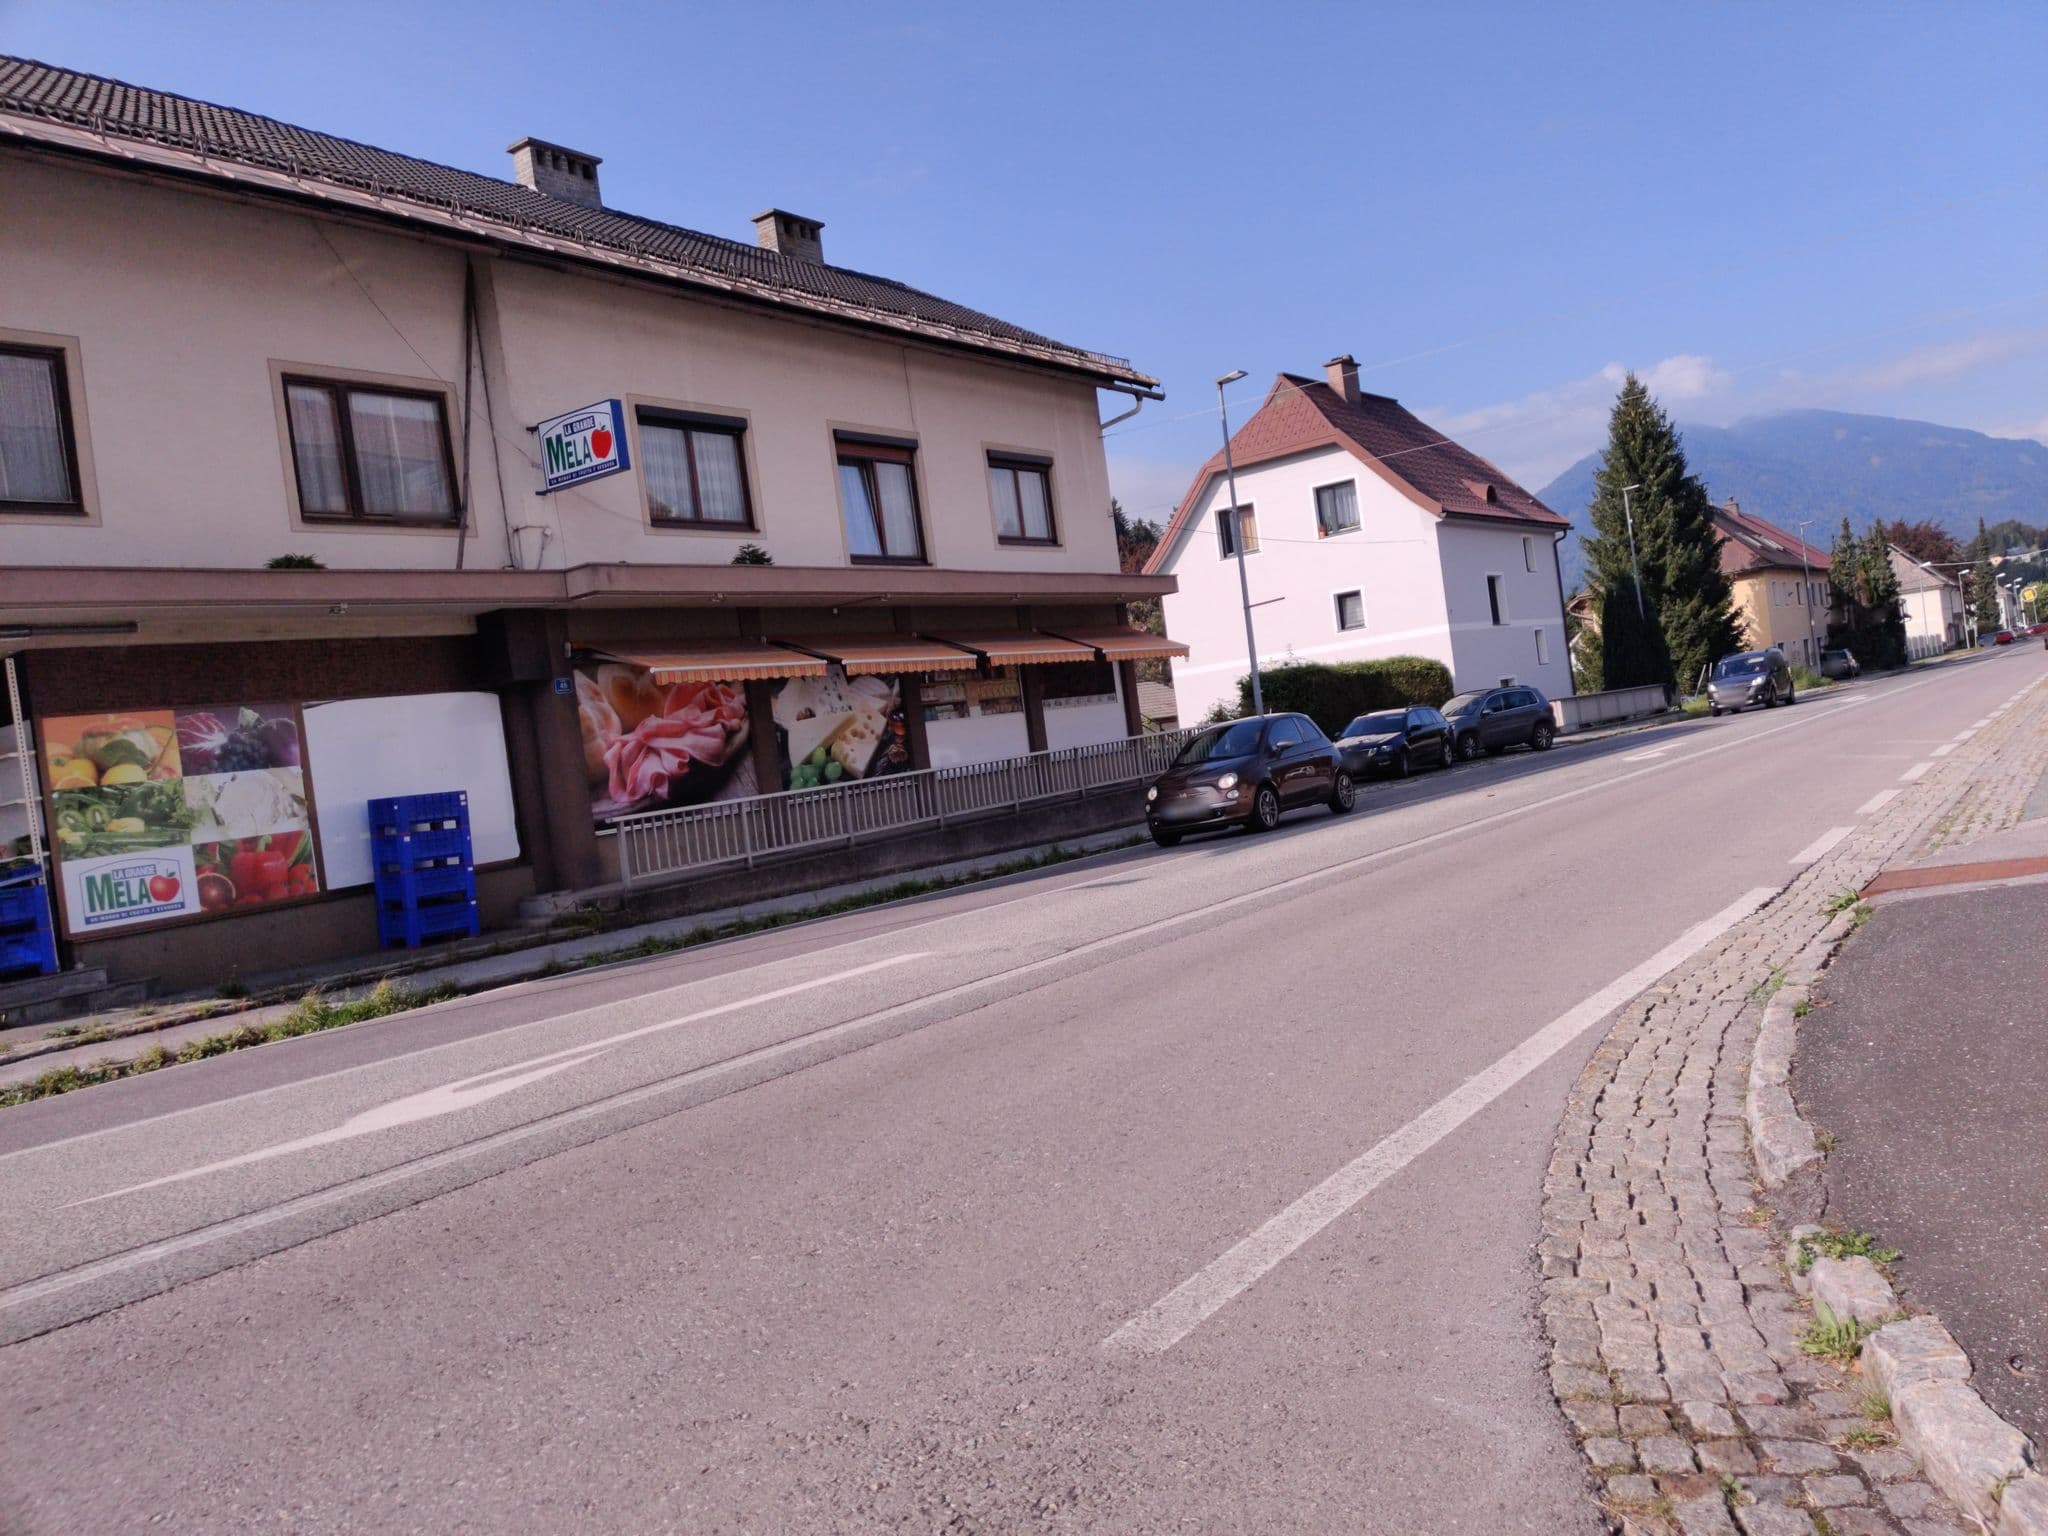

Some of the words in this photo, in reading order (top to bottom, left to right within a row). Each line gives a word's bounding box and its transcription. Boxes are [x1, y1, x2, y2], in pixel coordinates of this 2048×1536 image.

[564, 424, 573, 435] LA
[545, 433, 593, 475] MELA
[113, 868, 125, 880] LA
[85, 873, 153, 913] MELA
